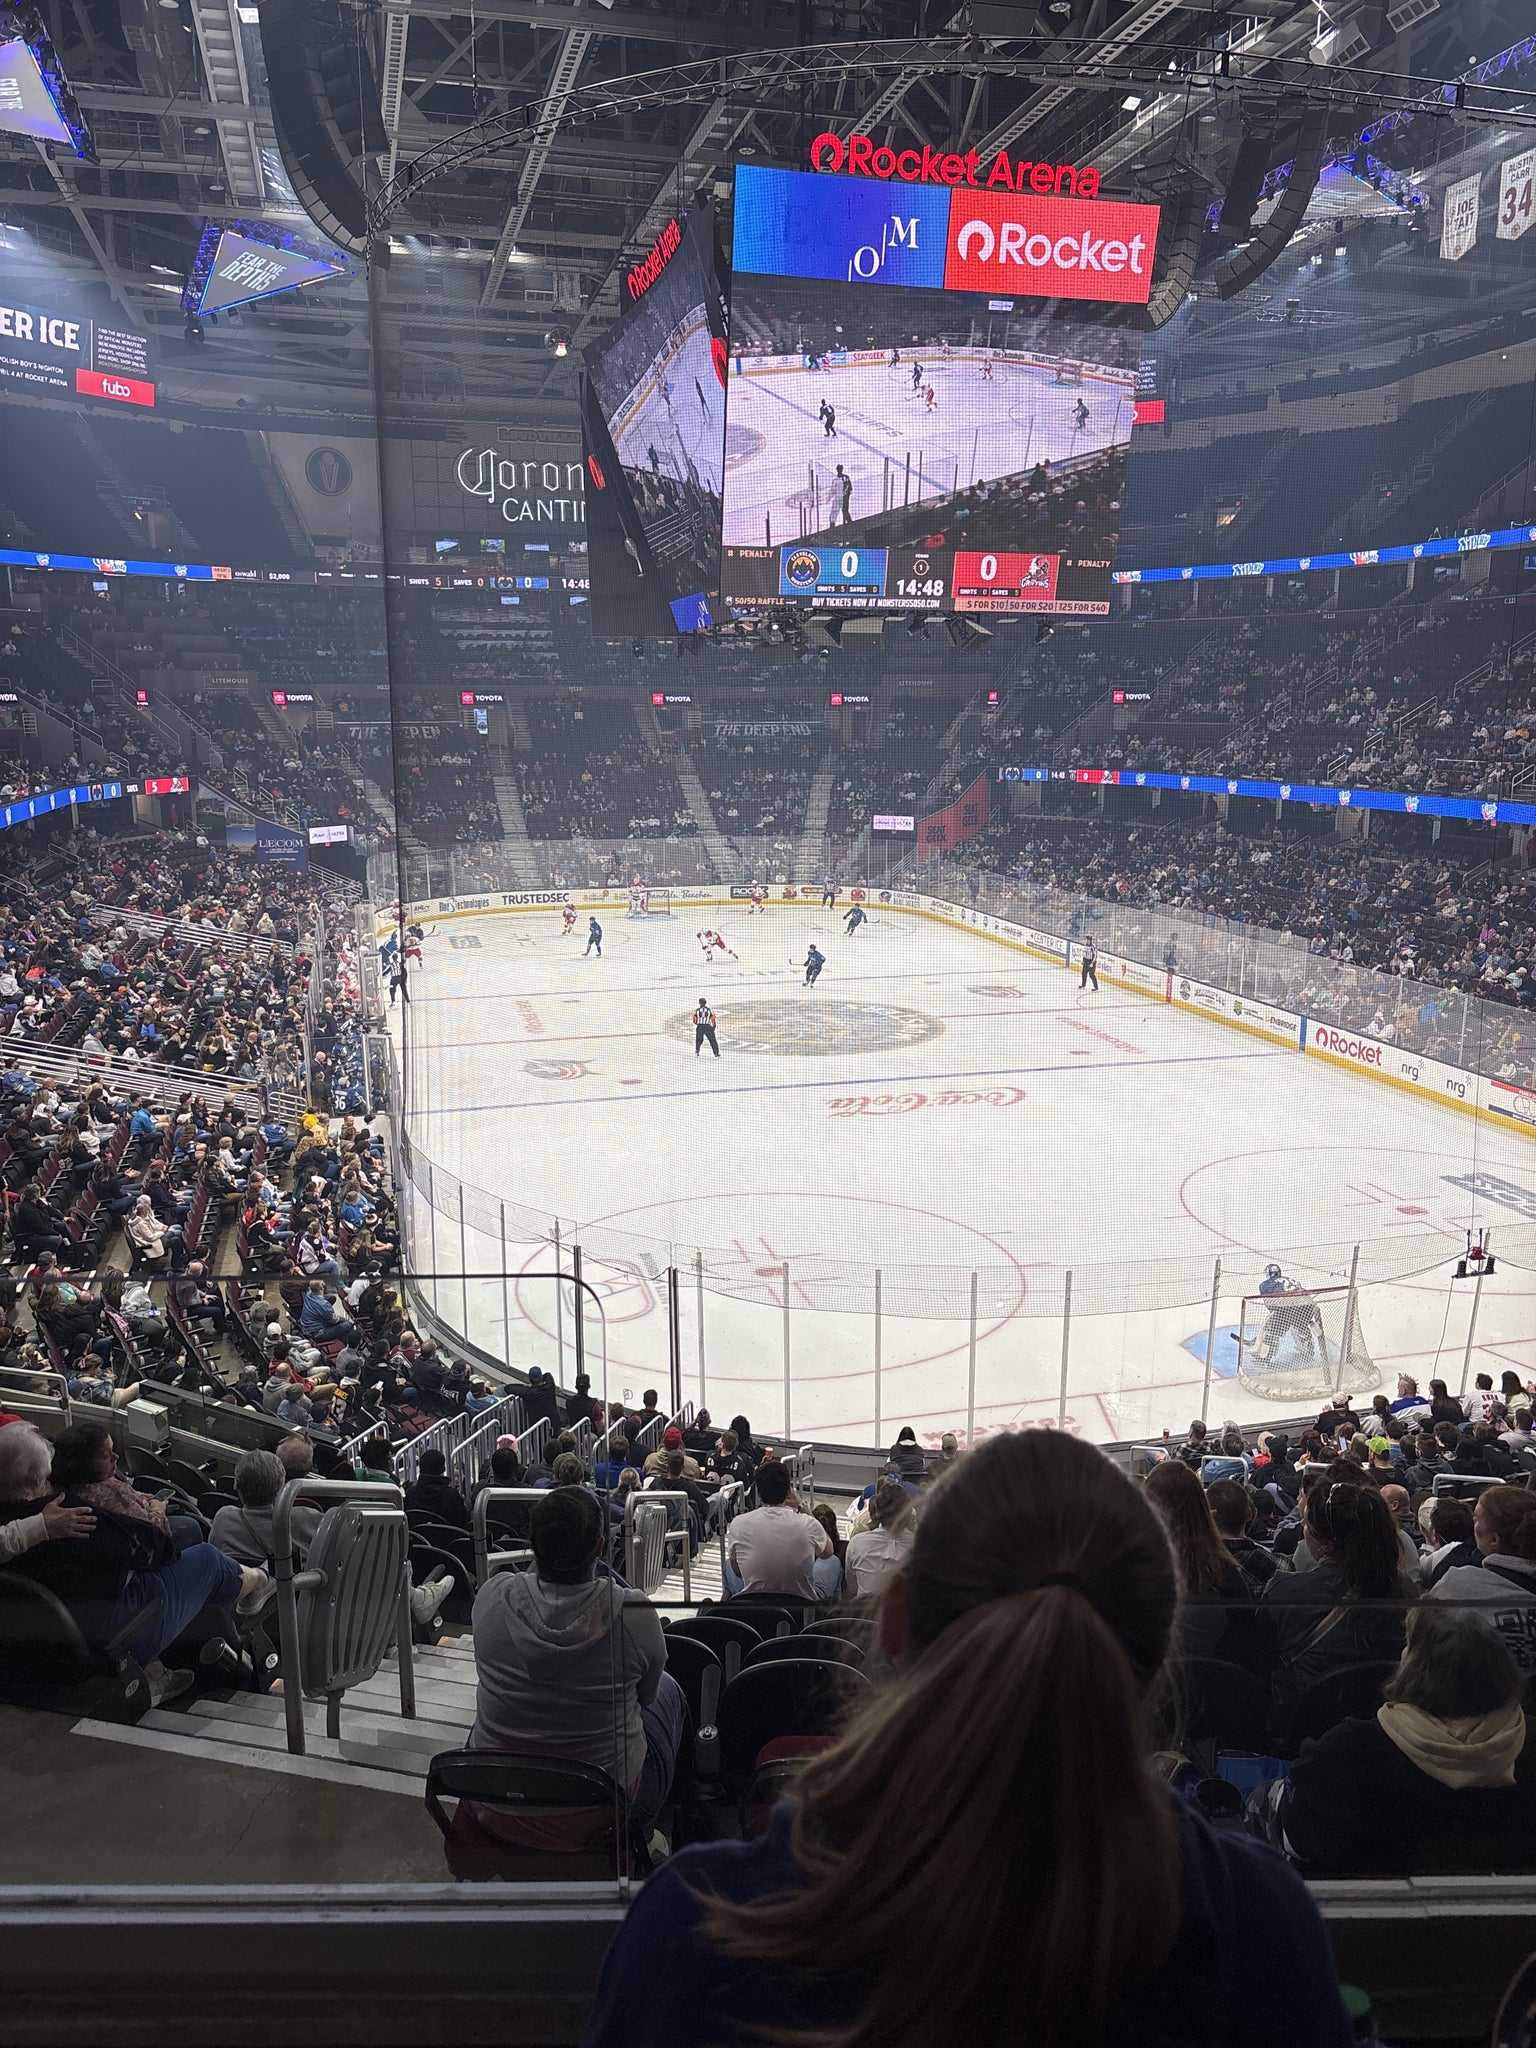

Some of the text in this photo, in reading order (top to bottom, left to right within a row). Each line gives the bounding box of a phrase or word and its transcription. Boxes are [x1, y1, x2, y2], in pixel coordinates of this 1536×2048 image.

[848, 135, 1101, 198] Rocket Arena
[1508, 155, 1534, 174] AUSTIN
[1510, 166, 1531, 183] CARR
[1457, 197, 1475, 216] JOE
[1502, 178, 1533, 225] 34
[634, 218, 681, 297] Rocket Arena
[999, 222, 1147, 275] Rocket
[236, 251, 288, 276] FEAR THE
[218, 260, 277, 291] DEPTHS
[40, 316, 80, 350] ICE
[24, 372, 48, 382] ROCKET
[48, 378, 68, 386] ARENA
[102, 378, 131, 397] fubo
[739, 549, 774, 558] PENALTY
[840, 551, 859, 578] 0
[980, 555, 998, 581] 0
[1078, 560, 1111, 568] PENALTY
[409, 578, 430, 586] SHOTS
[436, 578, 442, 586] 5
[453, 579, 473, 587] SAVES
[478, 578, 484, 588] 0
[524, 577, 532, 588] 0
[896, 579, 944, 597] 14:48
[812, 597, 826, 606] BUY
[826, 598, 852, 606] TICKETS
[852, 598, 868, 607] NOW
[868, 598, 877, 607] AT
[974, 600, 988, 608] FOR
[990, 600, 1004, 610] $10
[1010, 602, 1020, 610] 50
[1021, 602, 1037, 610] FOR
[1038, 602, 1054, 610] $20
[1060, 602, 1073, 611] 125
[1074, 603, 1089, 612] FOR
[1090, 604, 1106, 612] $40
[350, 727, 379, 740] THE
[714, 724, 812, 737] THE DEEP END
[1051, 771, 1066, 779] 14:48
[110, 786, 116, 796] 0
[152, 782, 158, 792] 5
[927, 825, 946, 833] SEAT
[454, 898, 490, 910] Technologies
[502, 892, 570, 905] TRUSTEDSEC
[1034, 932, 1054, 947] CENTER
[1055, 938, 1063, 952] ICE
[1270, 1016, 1297, 1032] ENBRIDGE
[1329, 1031, 1383, 1067] Rocket
[1401, 1062, 1420, 1082] nrg
[1446, 1078, 1466, 1098] nrg
[268, 1654, 278, 1666] 15
